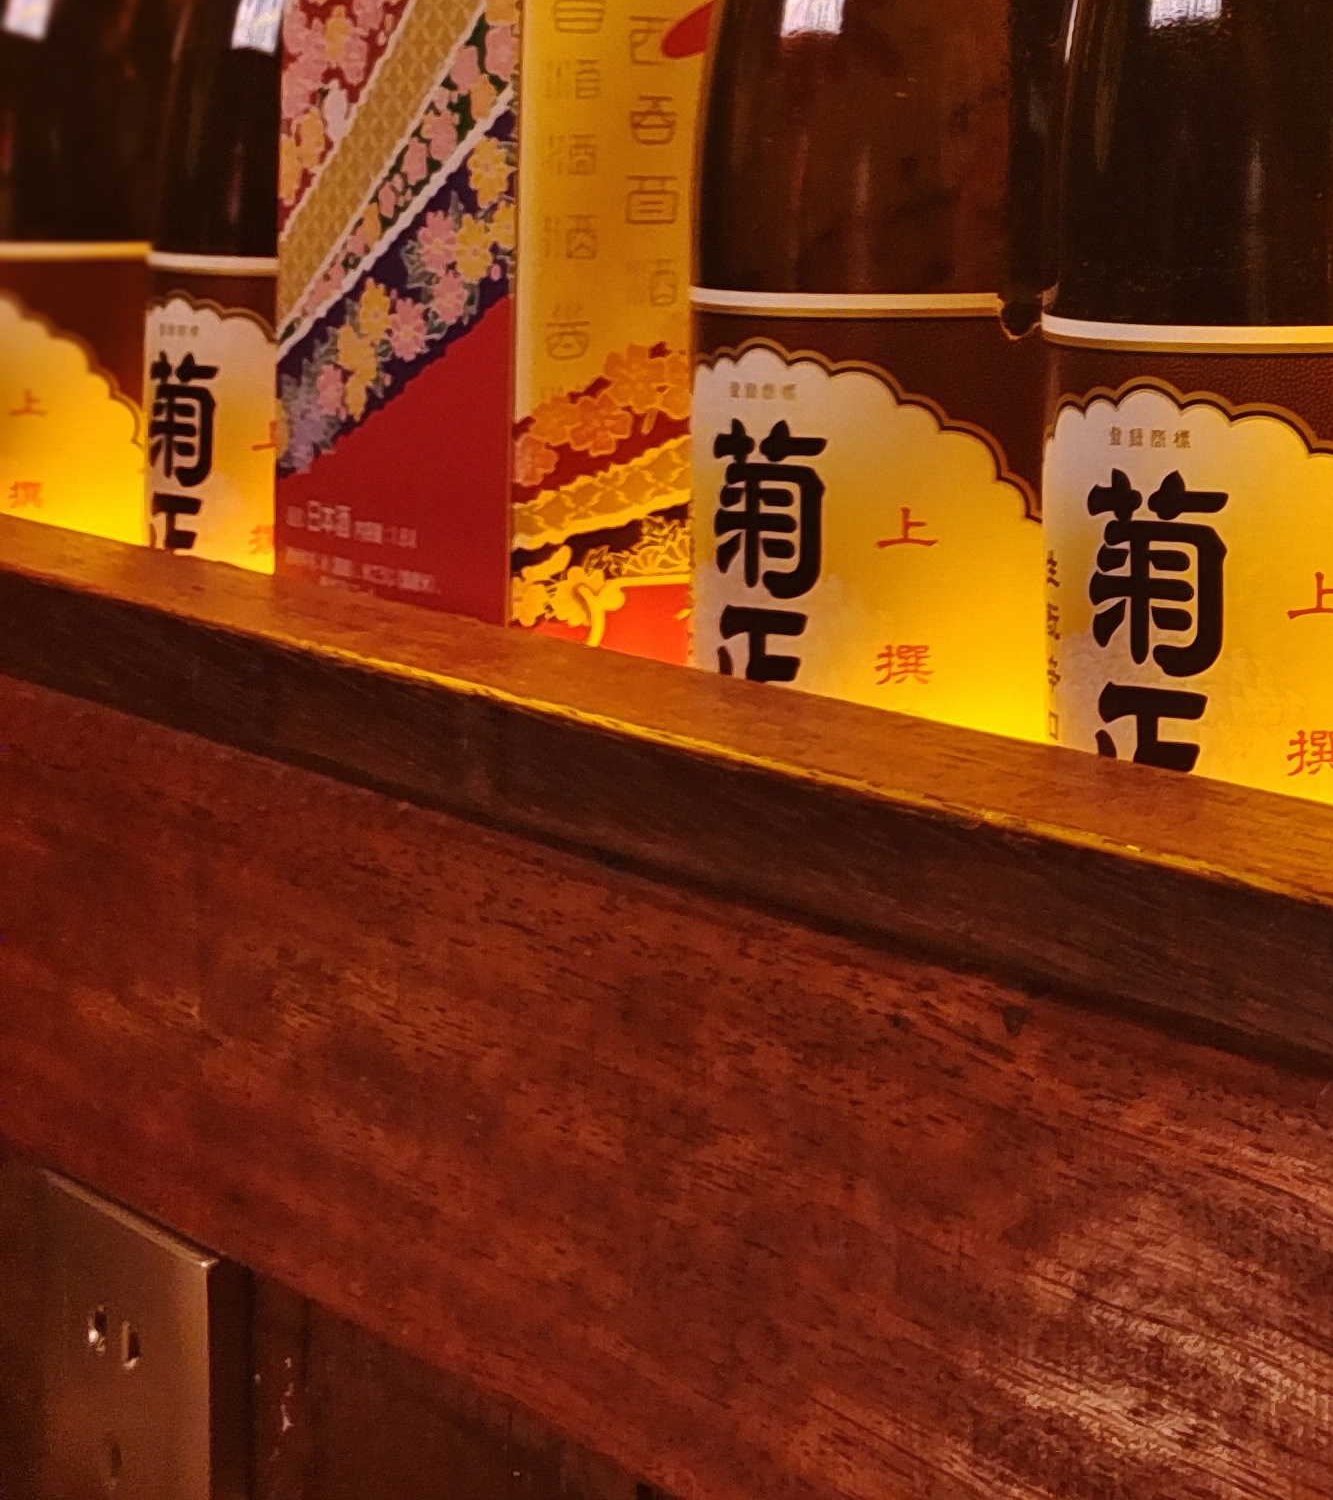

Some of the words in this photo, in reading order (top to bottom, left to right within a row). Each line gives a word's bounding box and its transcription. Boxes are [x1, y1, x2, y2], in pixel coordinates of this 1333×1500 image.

[713, 417, 828, 683] 菊正
[874, 507, 938, 686] 上撰
[1087, 467, 1230, 773] 菊正
